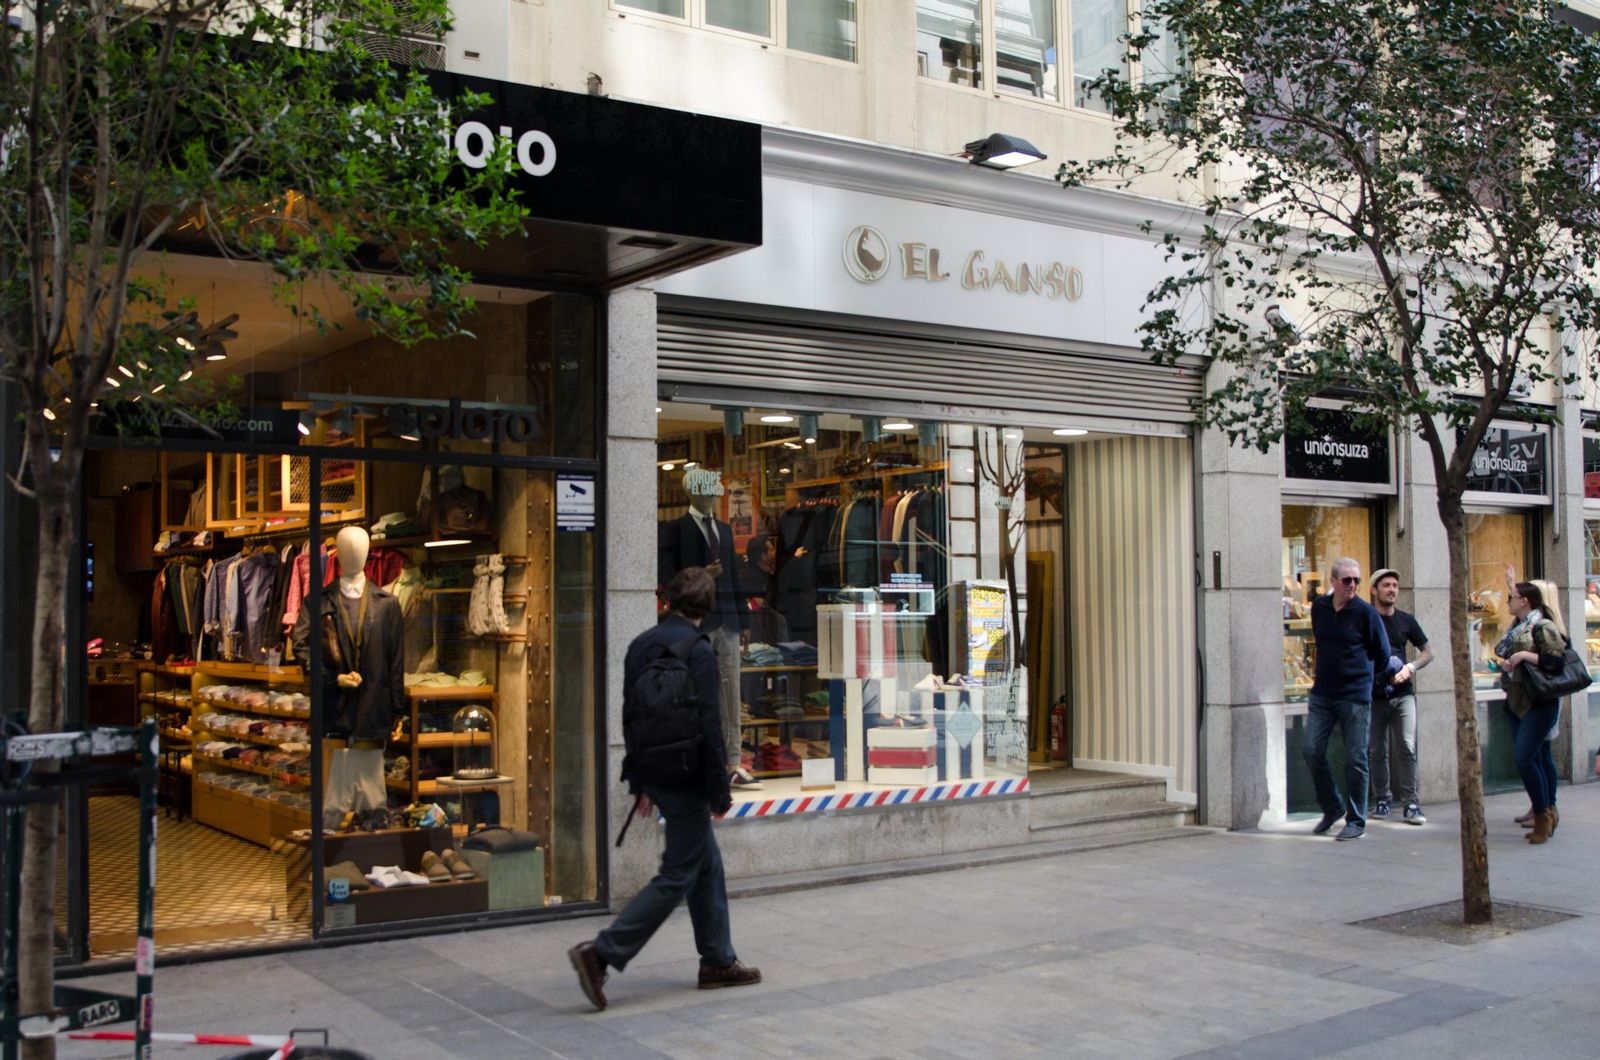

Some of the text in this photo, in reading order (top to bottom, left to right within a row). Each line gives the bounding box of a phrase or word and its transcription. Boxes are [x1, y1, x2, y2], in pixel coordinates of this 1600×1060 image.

[898, 242, 1083, 301] EL GANSO
[80, 1000, 118, 1023] RARO
